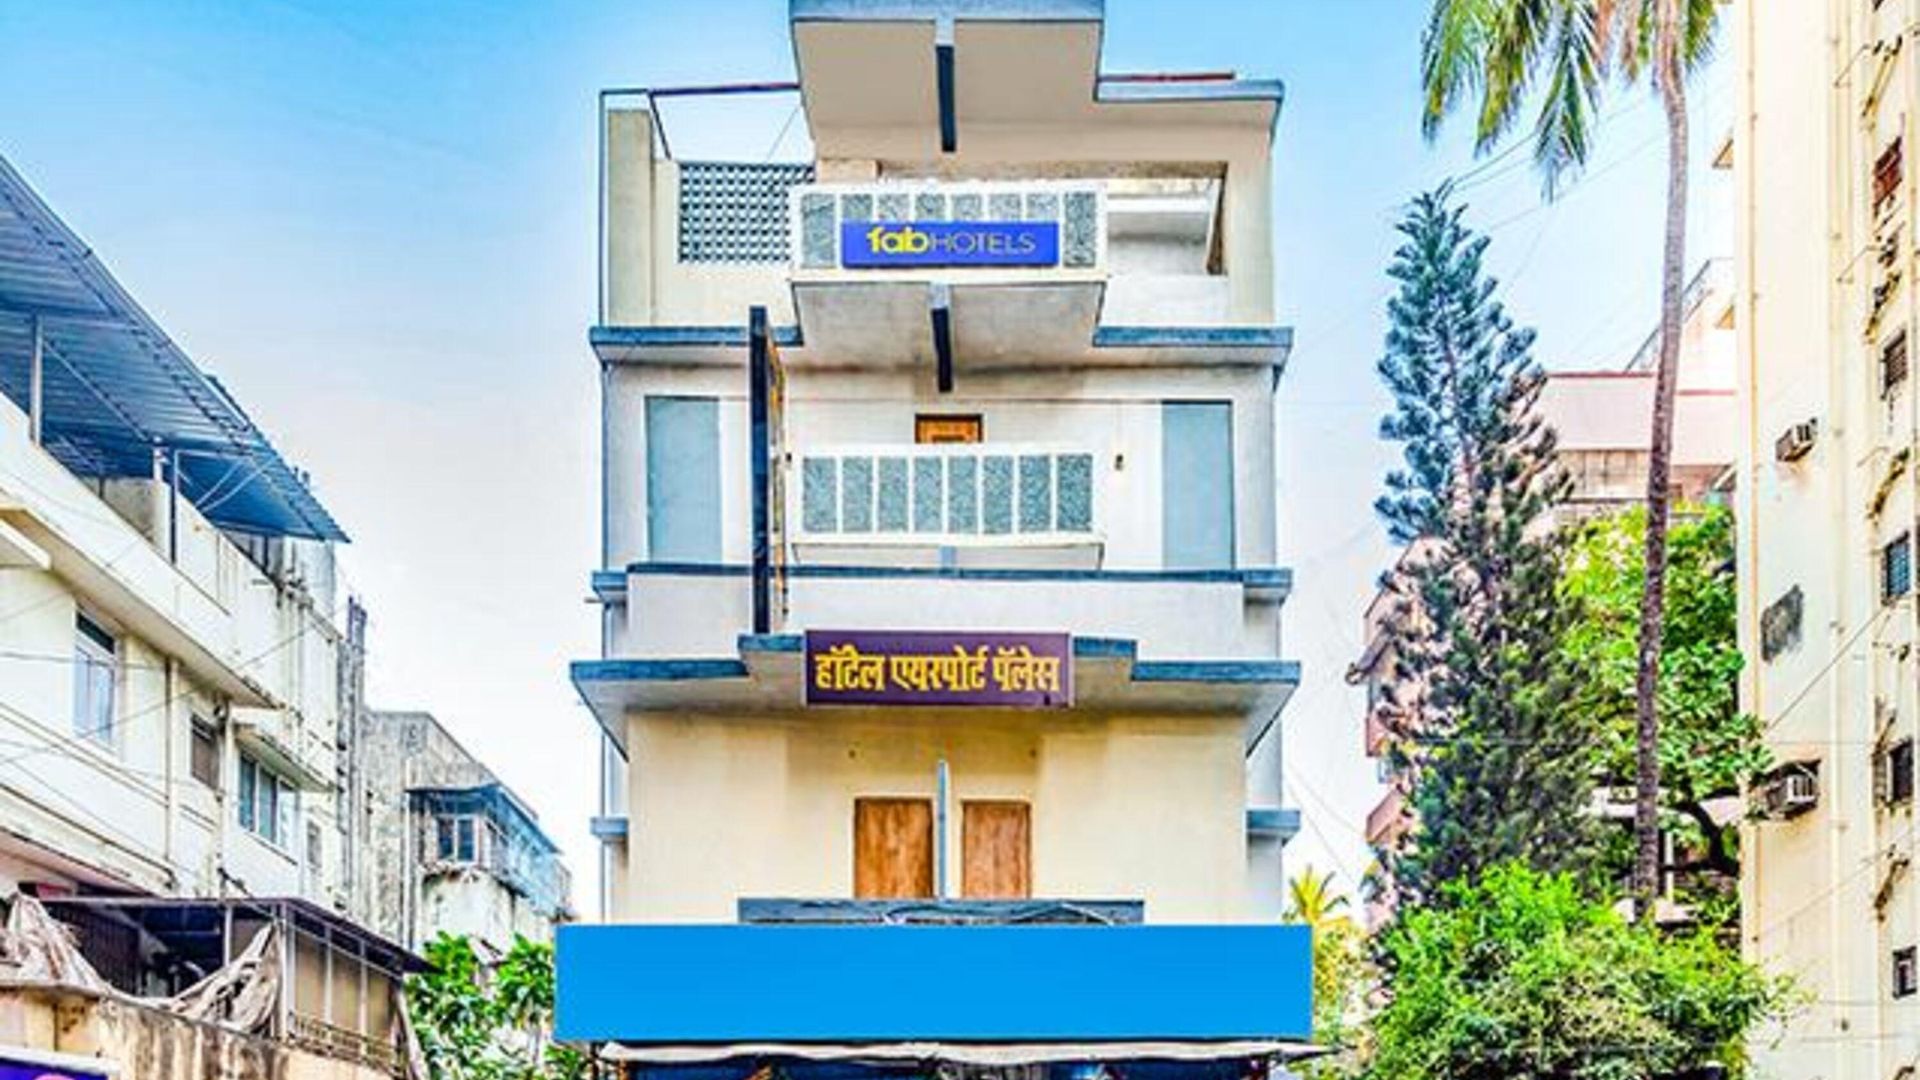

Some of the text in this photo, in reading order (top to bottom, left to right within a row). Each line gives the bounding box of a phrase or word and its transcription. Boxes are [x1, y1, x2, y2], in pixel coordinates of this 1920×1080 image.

[866, 226, 1036, 255] fabHOTELS
[814, 644, 886, 691] हॉटेल
[890, 644, 989, 692] एयरपोर्ट
